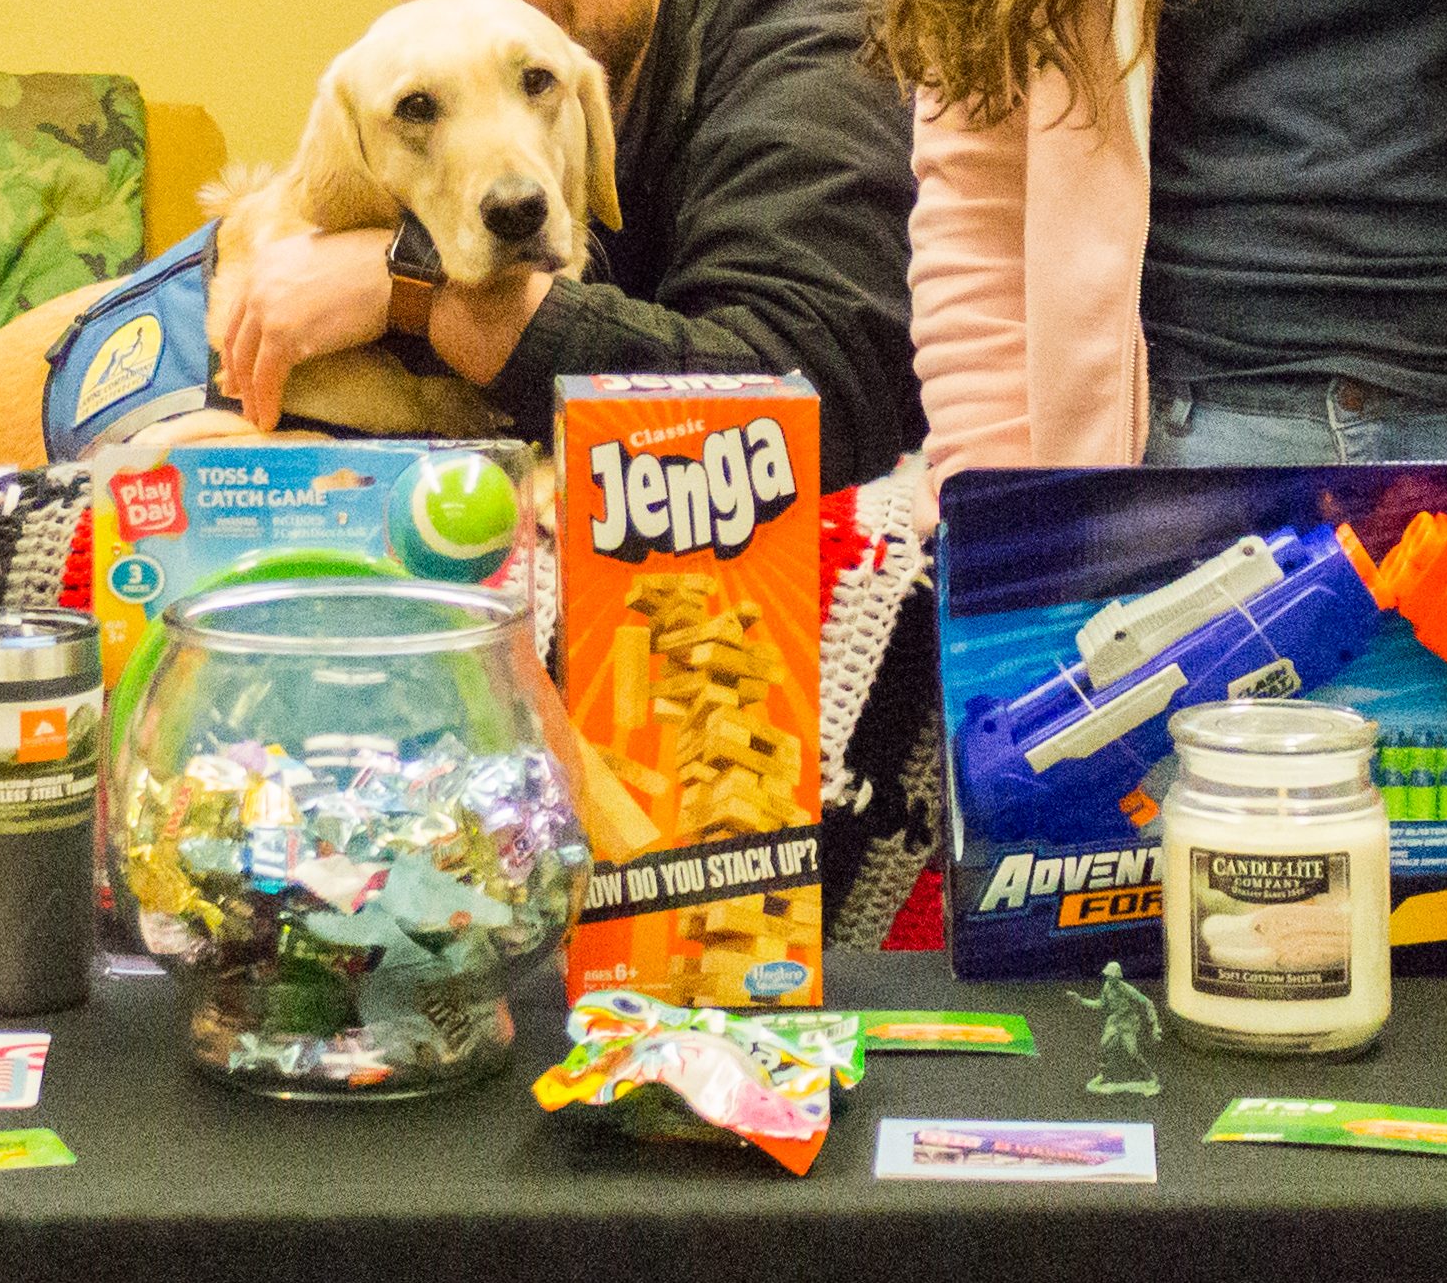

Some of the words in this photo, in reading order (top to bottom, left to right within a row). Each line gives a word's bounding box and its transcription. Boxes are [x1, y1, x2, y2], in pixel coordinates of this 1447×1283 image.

[629, 418, 706, 448] Classic
[197, 468, 244, 485] TOSS
[248, 468, 269, 485] &
[590, 417, 797, 553] Jenga
[120, 478, 173, 505] Play
[196, 490, 264, 508] CATCH
[267, 490, 327, 507] GAME
[127, 500, 177, 527] Day
[127, 564, 143, 584] 3
[29, 785, 64, 801] STEEL
[585, 872, 624, 909] OW
[626, 867, 659, 903] DO
[659, 858, 706, 897] YOU
[706, 845, 776, 889] STACK
[776, 837, 819, 876] UP?
[978, 847, 1163, 912] ADVENT
[1233, 878, 1301, 889] COMPANY
[1079, 890, 1162, 919] FOR
[614, 963, 639, 981] 6+
